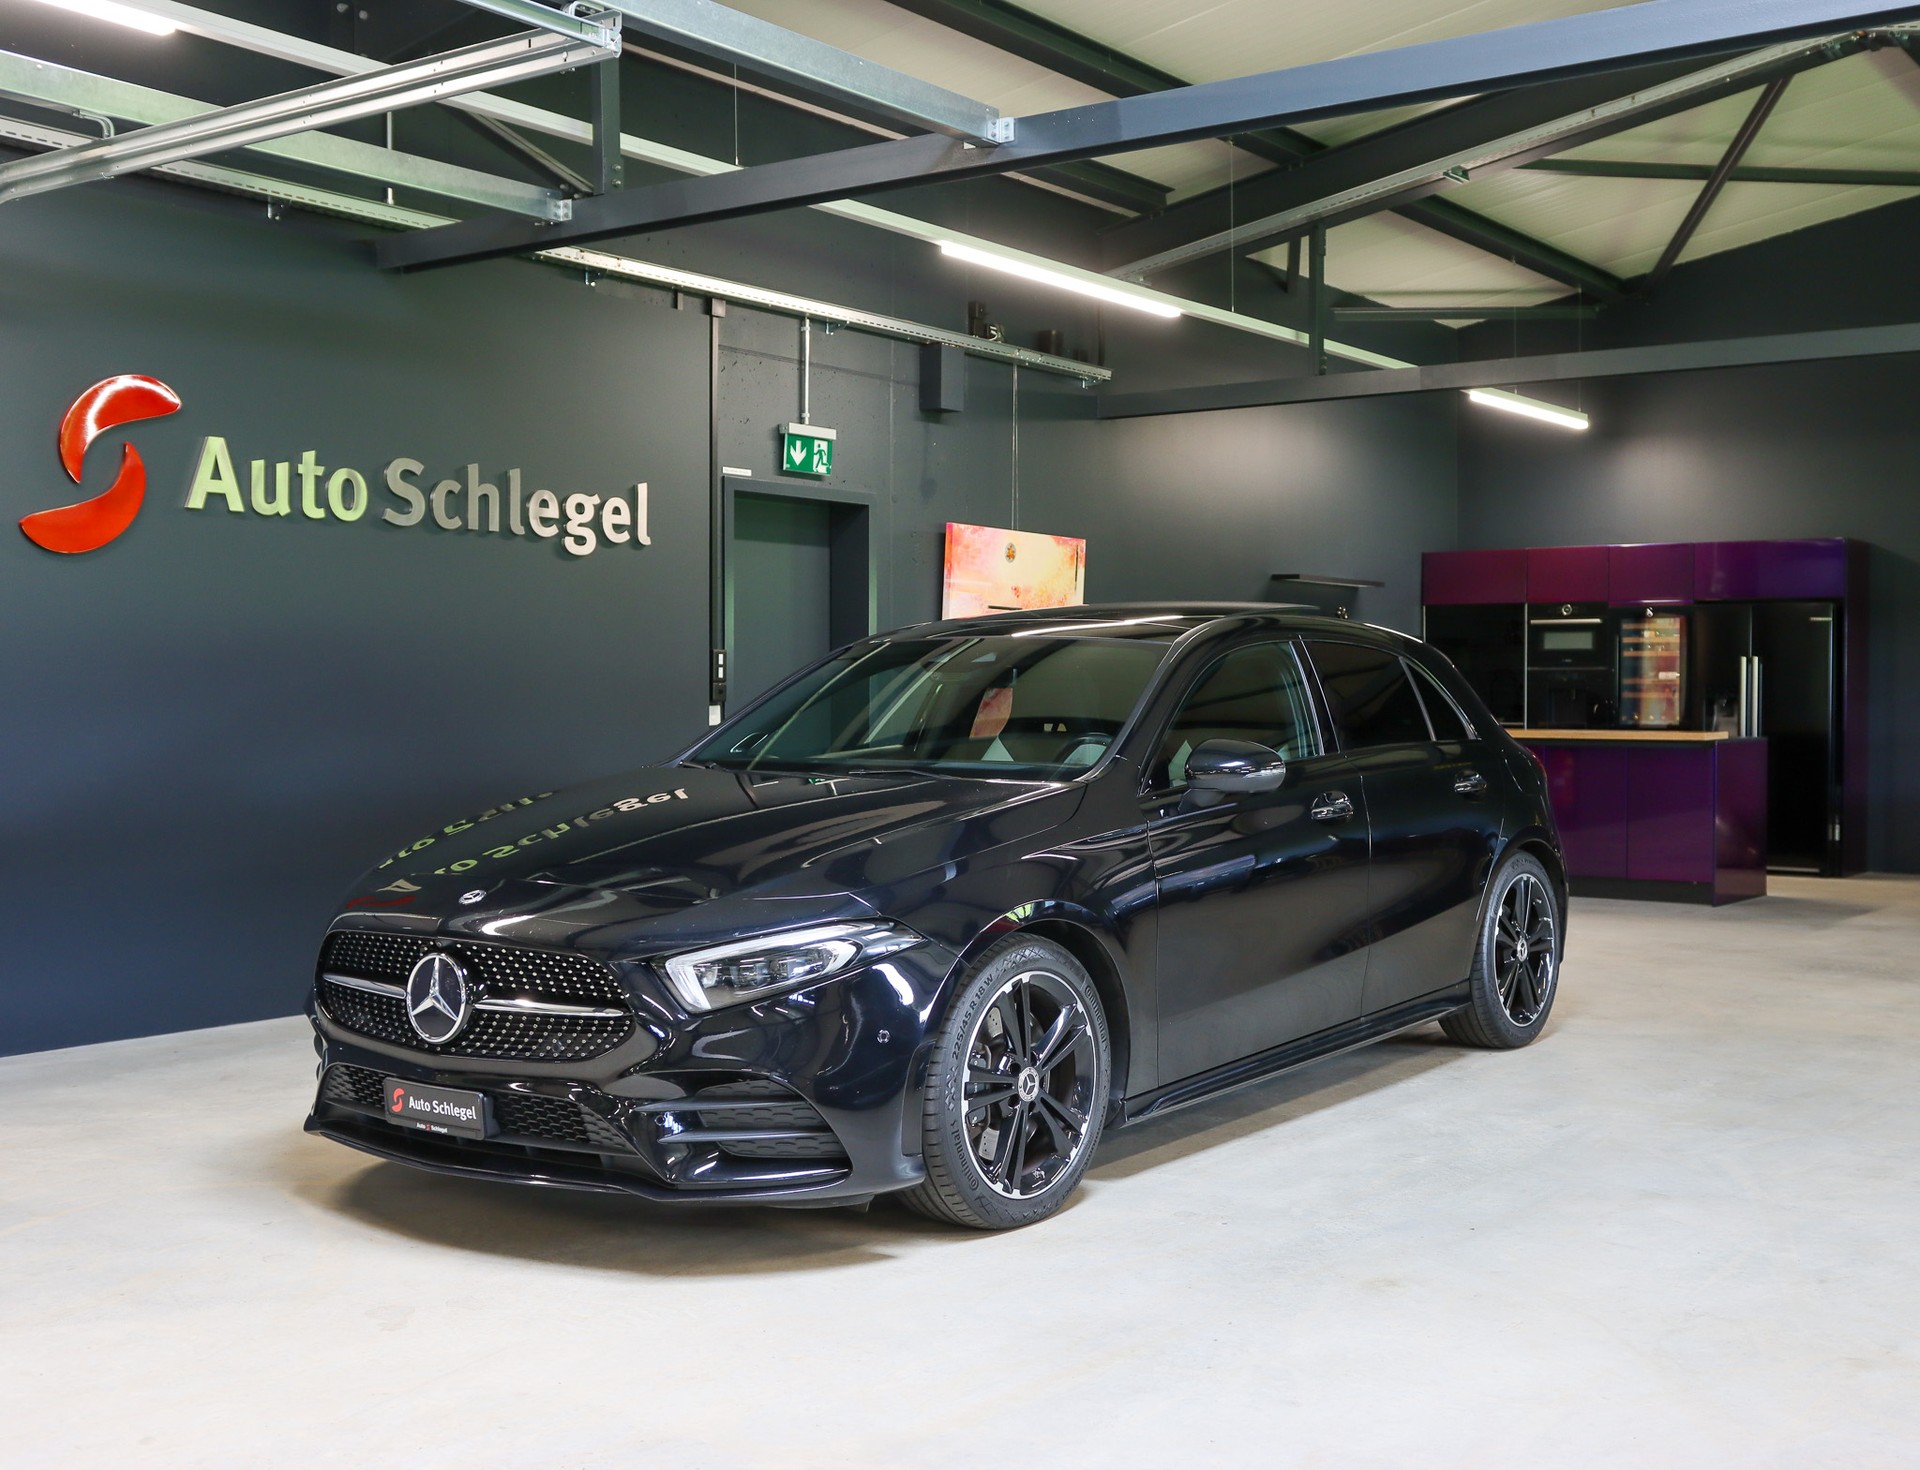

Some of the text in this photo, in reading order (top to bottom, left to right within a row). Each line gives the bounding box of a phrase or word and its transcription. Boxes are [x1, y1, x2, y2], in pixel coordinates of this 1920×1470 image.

[185, 436, 651, 556] Auto Schlegel
[952, 974, 993, 1060] 225/45 R 18 W
[1085, 986, 1107, 1043] Continental
[409, 1096, 477, 1121] Auto Schlegel
[951, 1129, 979, 1191] Continental
